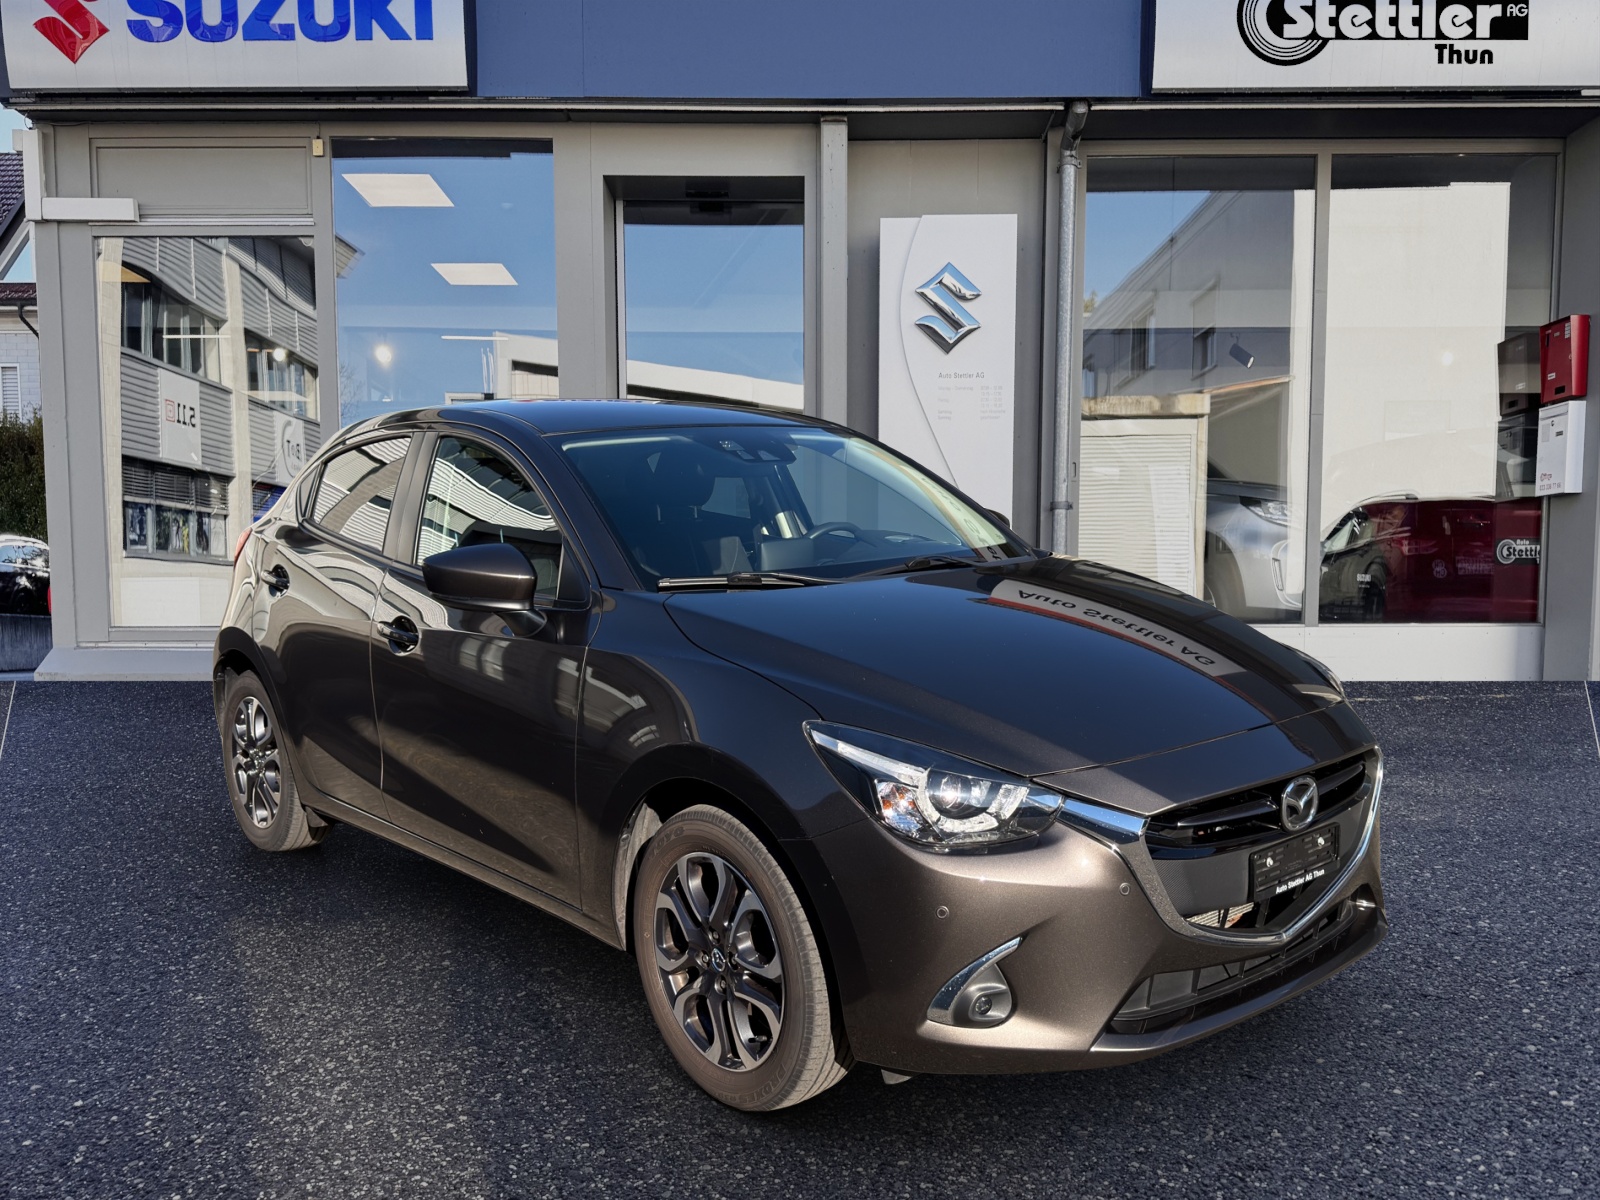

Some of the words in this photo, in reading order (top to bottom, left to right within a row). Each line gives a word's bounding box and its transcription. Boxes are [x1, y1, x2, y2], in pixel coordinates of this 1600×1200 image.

[1282, 0, 1502, 39] Stettler
[1507, 4, 1528, 17] AG
[1435, 43, 1493, 64] Thun
[1276, 885, 1287, 894] Auto
[1288, 877, 1305, 888] Stettler
[1305, 872, 1313, 882] AG
[1313, 869, 1325, 878] Thun
